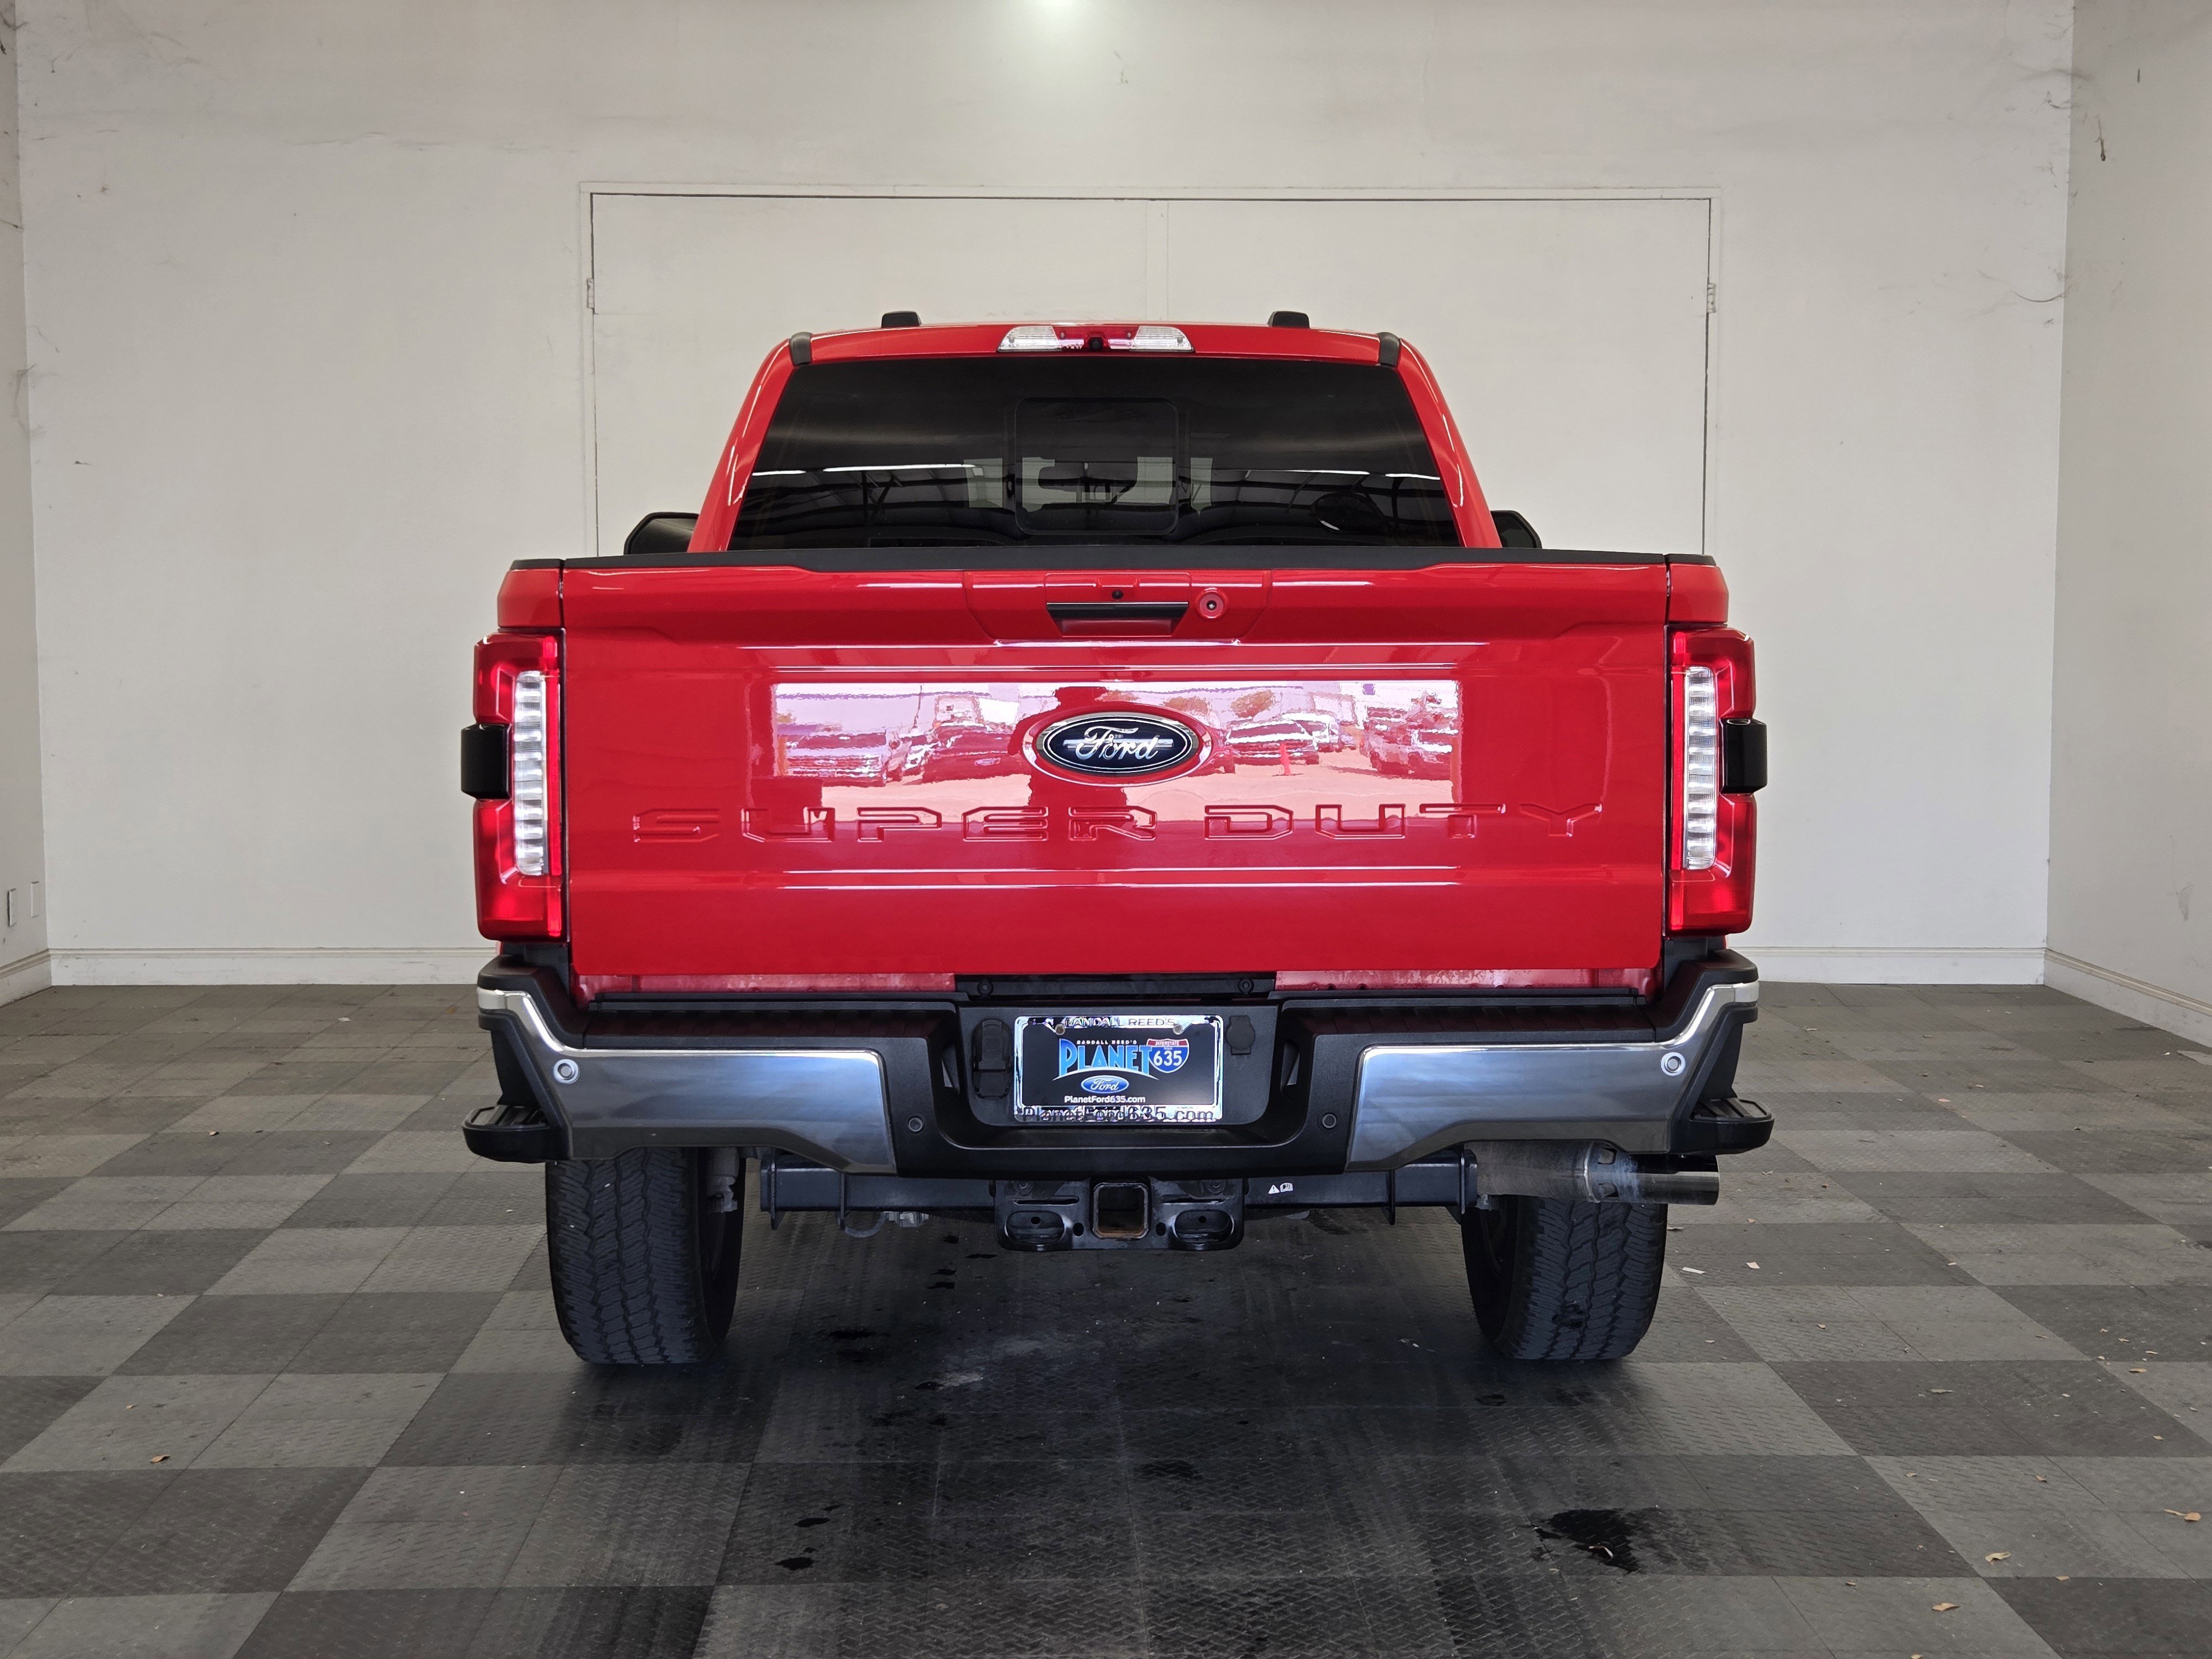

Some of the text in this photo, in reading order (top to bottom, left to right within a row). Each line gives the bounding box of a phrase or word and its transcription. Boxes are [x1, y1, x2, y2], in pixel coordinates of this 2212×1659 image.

[1075, 726, 1161, 760] Ford
[632, 803, 1604, 843] SUPER DUTY
[1059, 1038, 1152, 1077] PLANET
[1153, 1050, 1182, 1066] 635
[1090, 1079, 1120, 1092] Ford
[1064, 1095, 1146, 1104] PlanetFord635.com
